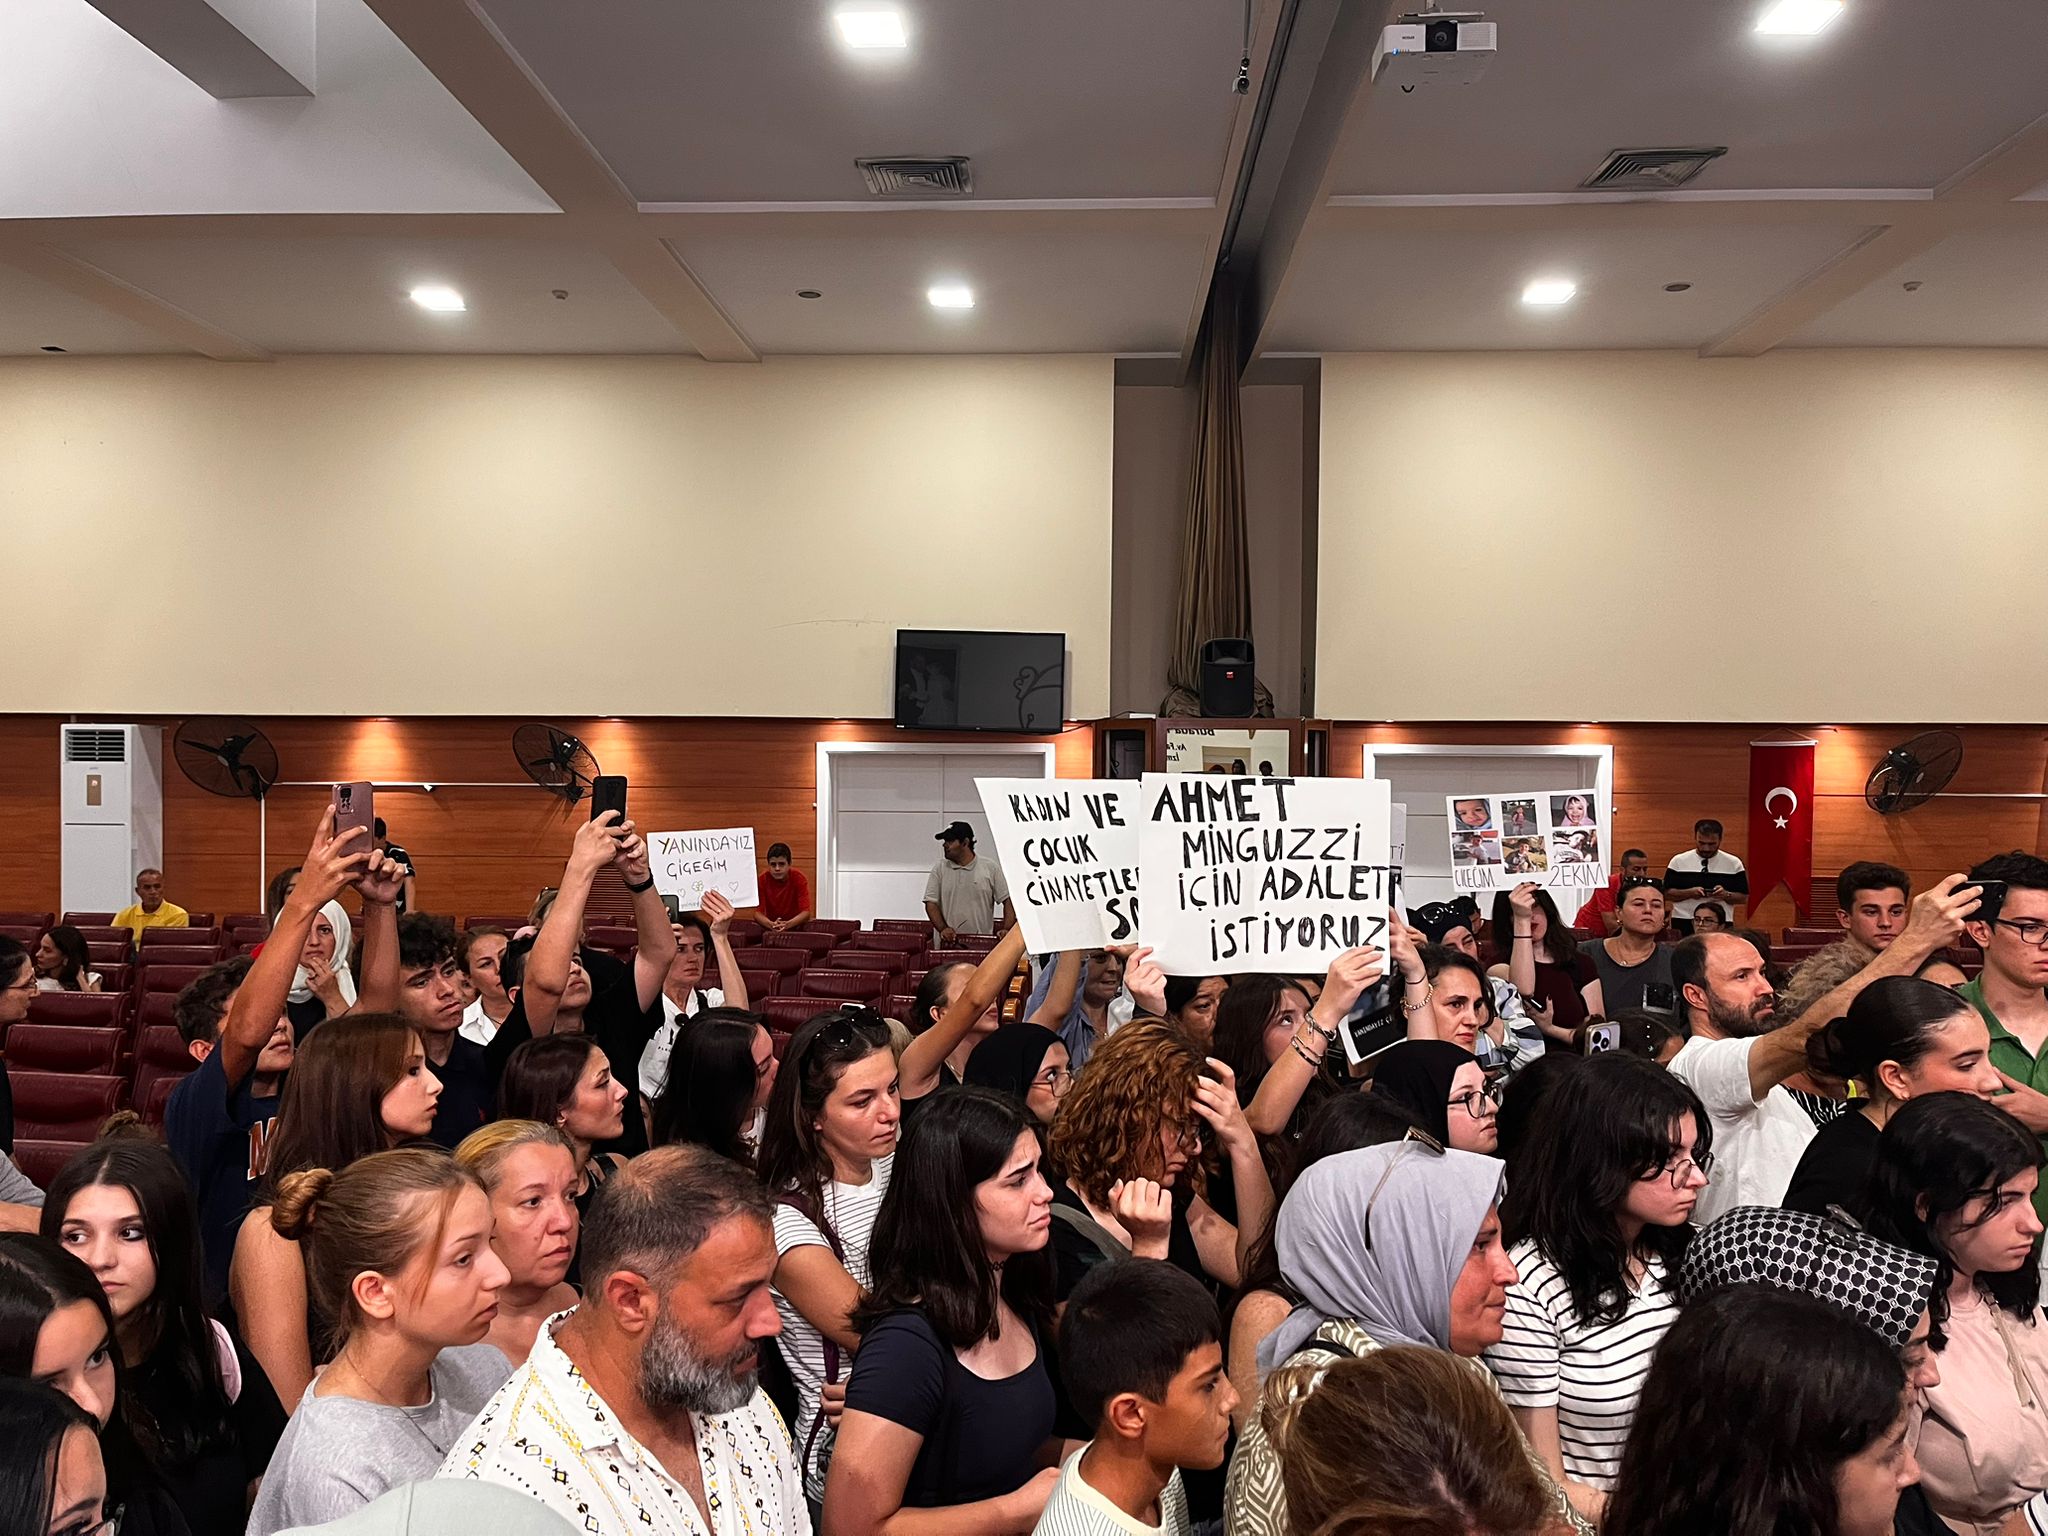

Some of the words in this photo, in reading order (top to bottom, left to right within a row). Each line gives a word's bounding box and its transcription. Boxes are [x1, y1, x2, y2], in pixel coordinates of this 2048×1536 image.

[1008, 791, 1071, 823] KADIN
[1083, 792, 1126, 829] VE
[1151, 777, 1296, 823] AHMET
[657, 836, 753, 855] YANINDAYIZ
[1023, 833, 1099, 873] ÇOCUK
[1183, 823, 1361, 869] MİNGUZZİ
[1178, 867, 1242, 912] İÇİN
[1259, 865, 1391, 902] ADALET
[1210, 912, 1387, 962] İSTİYORUZ
